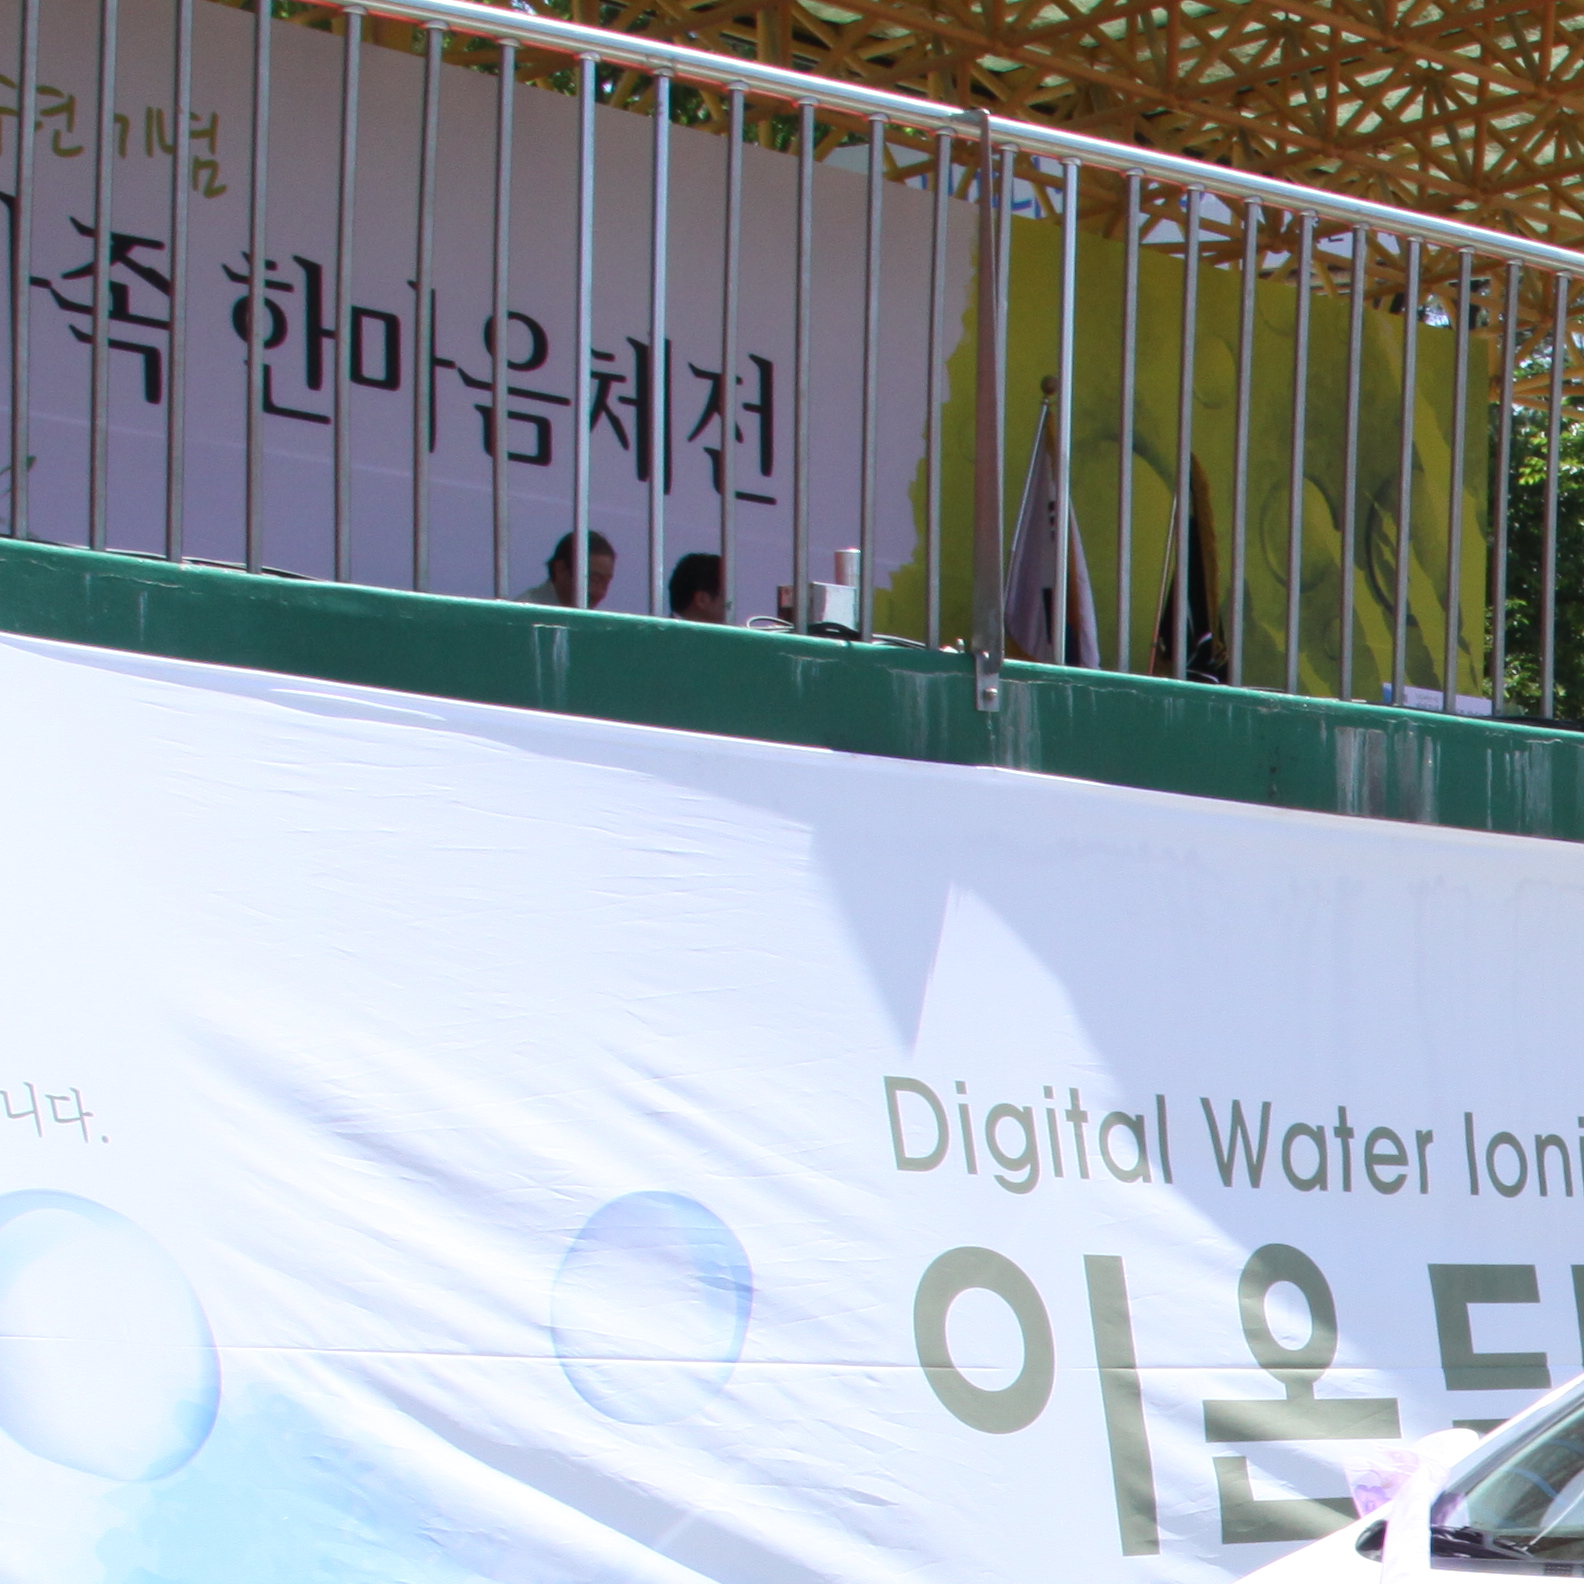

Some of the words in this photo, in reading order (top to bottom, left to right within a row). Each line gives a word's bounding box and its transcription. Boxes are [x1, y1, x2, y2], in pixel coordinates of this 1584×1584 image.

[112, 106, 228, 199] 기념
[883, 1075, 1174, 1195] Digital
[1199, 1096, 1434, 1195] Water
